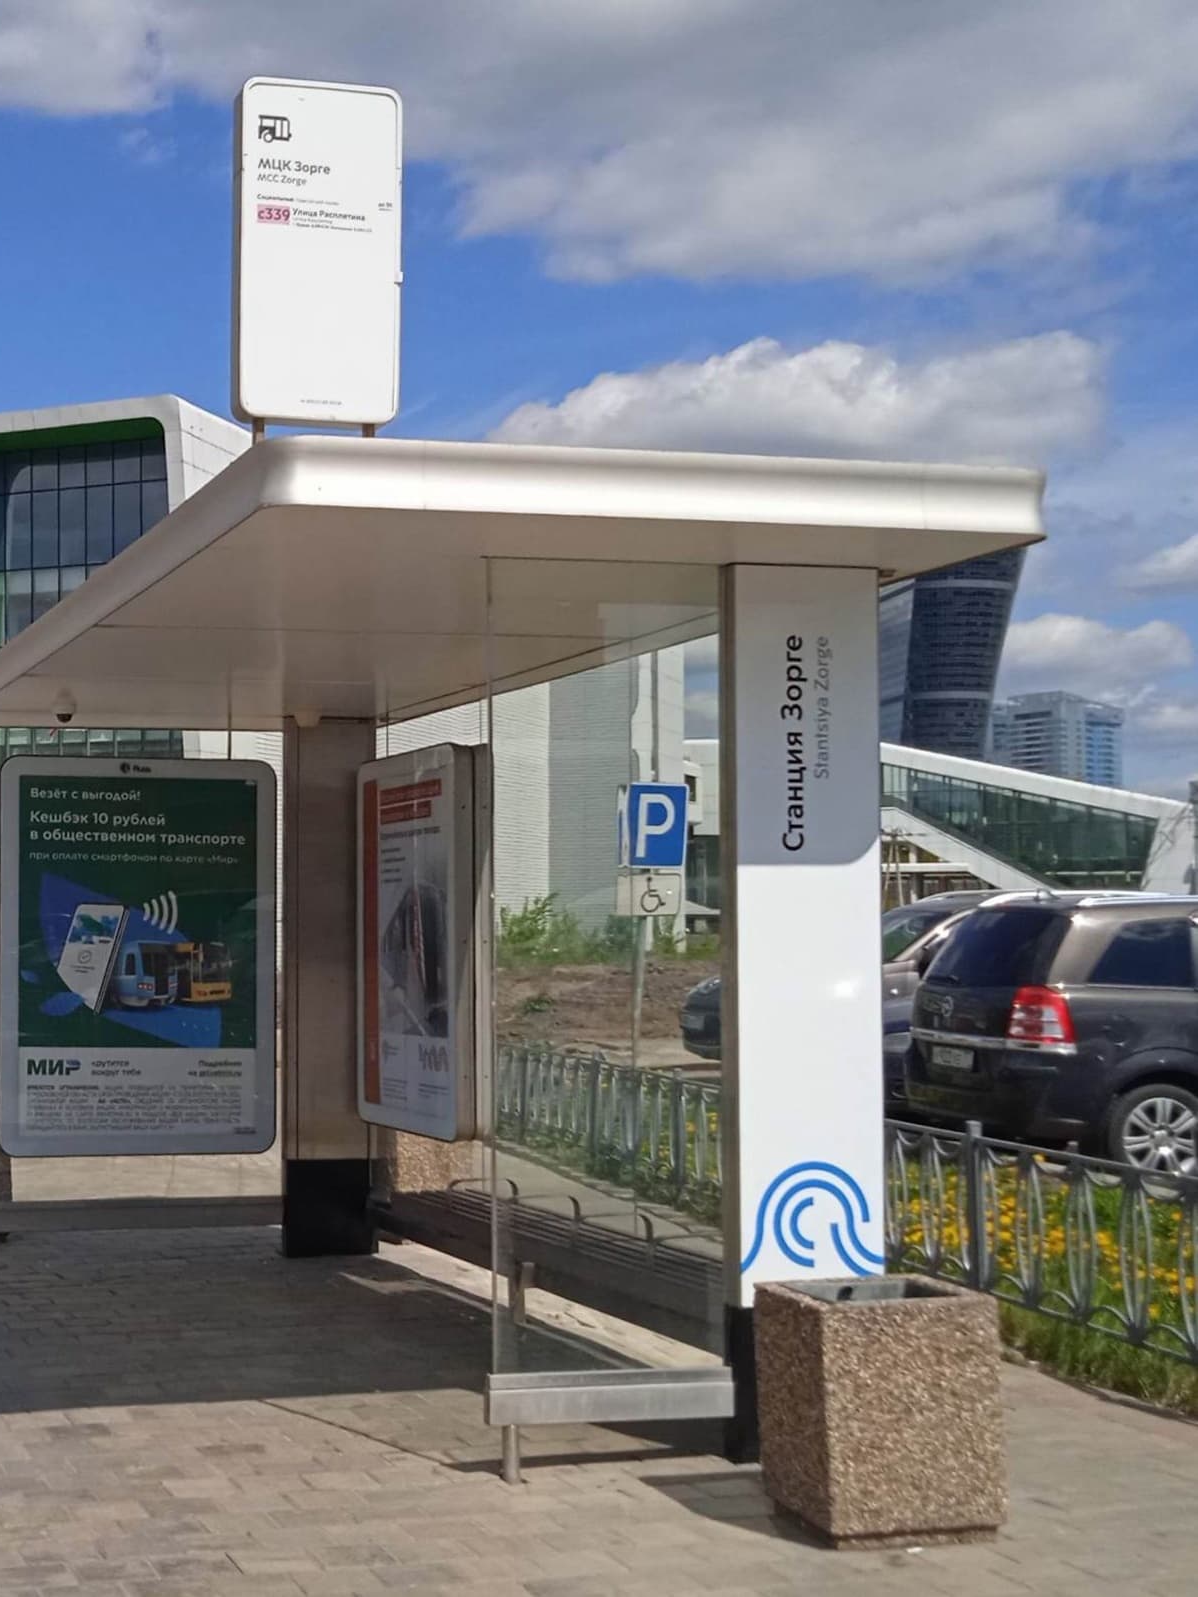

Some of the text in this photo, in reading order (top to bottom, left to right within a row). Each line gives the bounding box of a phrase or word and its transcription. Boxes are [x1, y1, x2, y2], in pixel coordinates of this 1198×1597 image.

[257, 157, 331, 176] МЦК Зорге
[257, 173, 307, 187] MCC Zorge
[292, 207, 318, 218] Улица
[319, 210, 366, 222] Расплетина
[814, 635, 833, 780] Stantsiya Zorge
[780, 634, 808, 852] Станция Зорге
[30, 787, 141, 802] Везёт с выгодой!
[30, 810, 166, 828] Кешбэк 10 рублей
[635, 793, 676, 858] P
[30, 828, 246, 847] в общественном транспорте
[29, 852, 50, 861] при
[52, 852, 89, 861] оплате
[90, 853, 158, 863] смартфоном
[159, 855, 173, 863] по
[174, 855, 203, 864] карте
[27, 1058, 81, 1076] МИР
